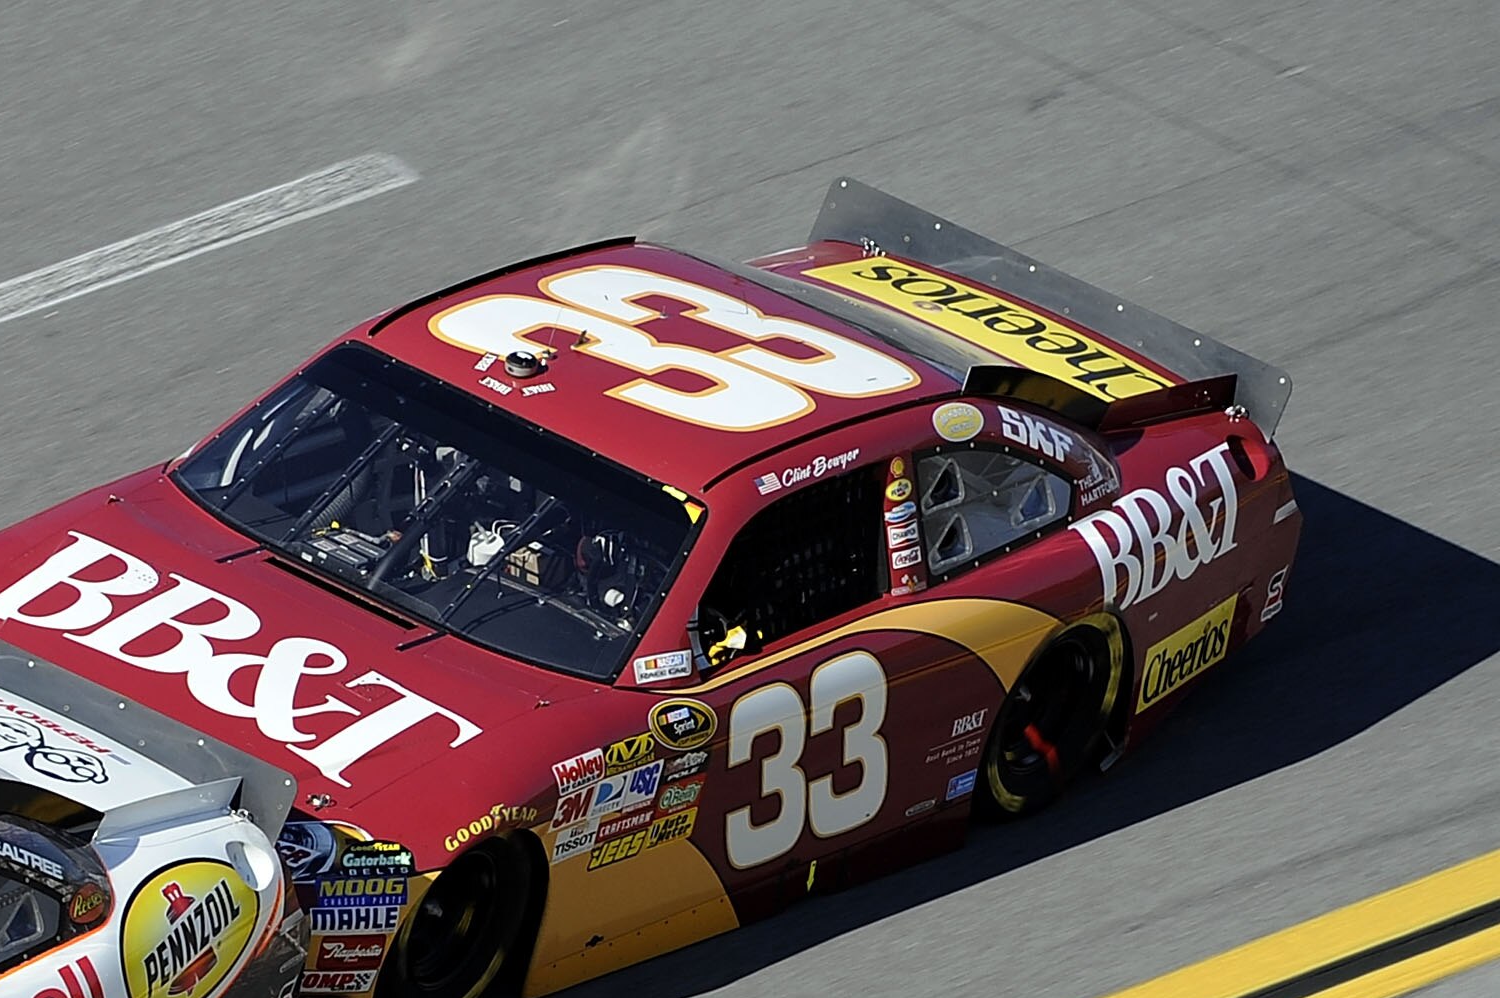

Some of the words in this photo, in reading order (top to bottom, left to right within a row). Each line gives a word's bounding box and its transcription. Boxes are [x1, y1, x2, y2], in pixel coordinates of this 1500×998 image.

[427, 264, 923, 433] 33
[997, 405, 1073, 463] SKF
[781, 464, 812, 487] Clint
[812, 448, 860, 478] Bowyer
[1068, 443, 1239, 611] BB&T
[640, 670, 666, 680] RACE
[668, 667, 689, 676] CAR
[1142, 619, 1229, 704] Cheerios
[673, 718, 696, 736] Sprint
[950, 708, 989, 737] BB&T
[554, 755, 603, 787] Holley
[667, 766, 701, 782] POLE
[725, 650, 889, 870] 33
[629, 763, 661, 796] USG
[552, 786, 596, 829] 3M
[444, 803, 538, 852] GOODYEAR
[599, 810, 653, 838] CRAFTSMAN
[659, 821, 692, 844] Meter
[662, 813, 689, 831] Auto
[554, 831, 596, 857] TISSOT
[589, 829, 648, 871] JEGS
[342, 852, 411, 867] Gatorback
[349, 867, 409, 876] BELTS
[320, 877, 405, 897] MOOG
[323, 897, 365, 906] CHASSIS
[372, 896, 403, 905] PARTS
[311, 907, 398, 931] MAHLE
[301, 973, 355, 989] OMP
